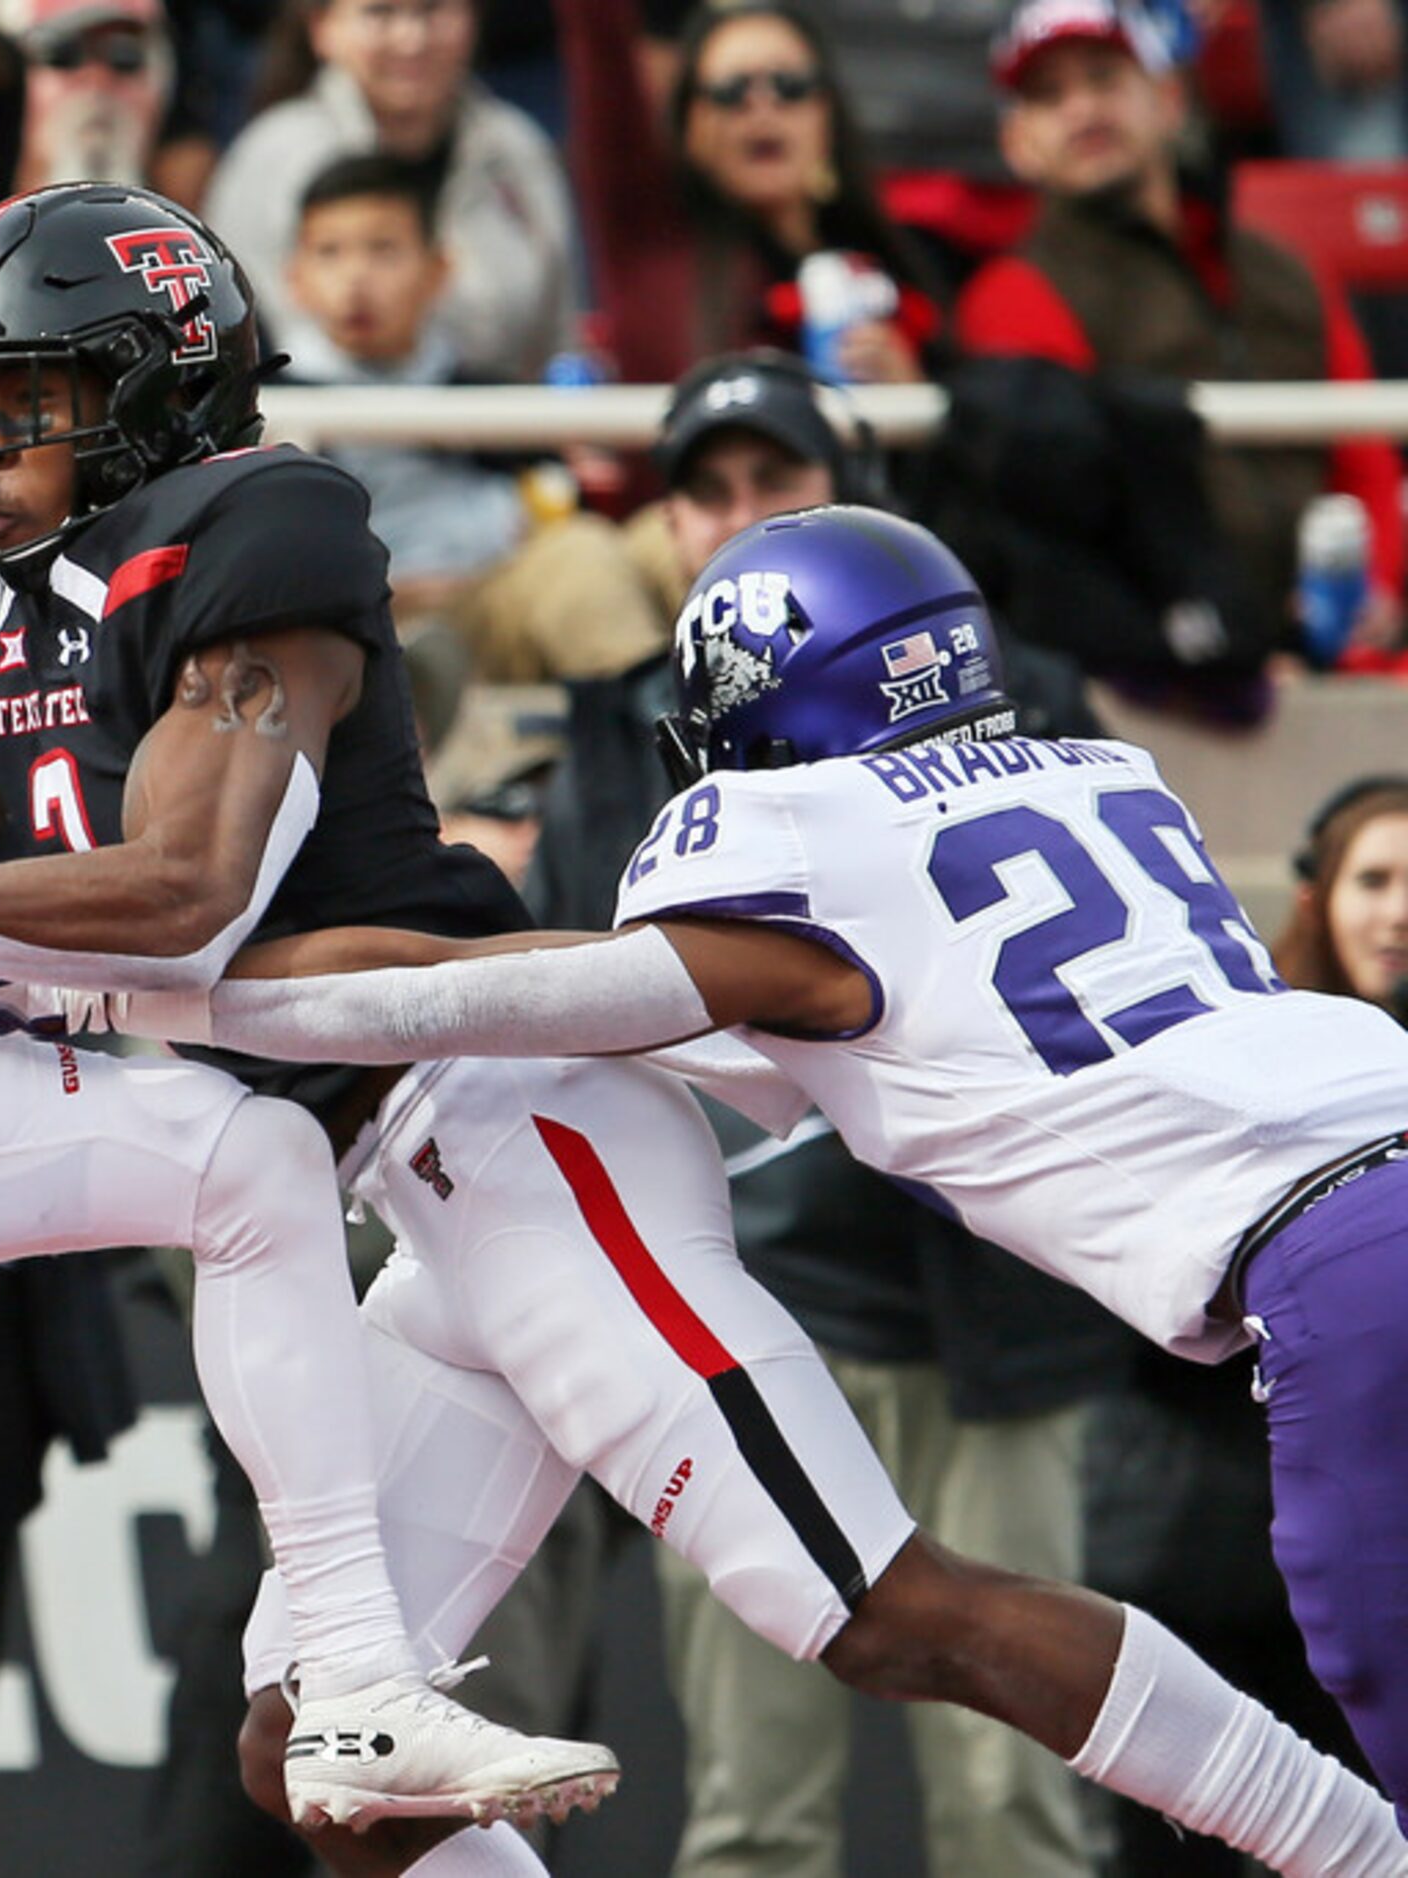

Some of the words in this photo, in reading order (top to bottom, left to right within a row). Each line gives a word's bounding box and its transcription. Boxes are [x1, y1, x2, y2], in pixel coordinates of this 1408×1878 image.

[676, 571, 792, 680] TCU
[949, 623, 979, 656] 28
[628, 782, 721, 888] 28
[926, 787, 1294, 1079] 28
